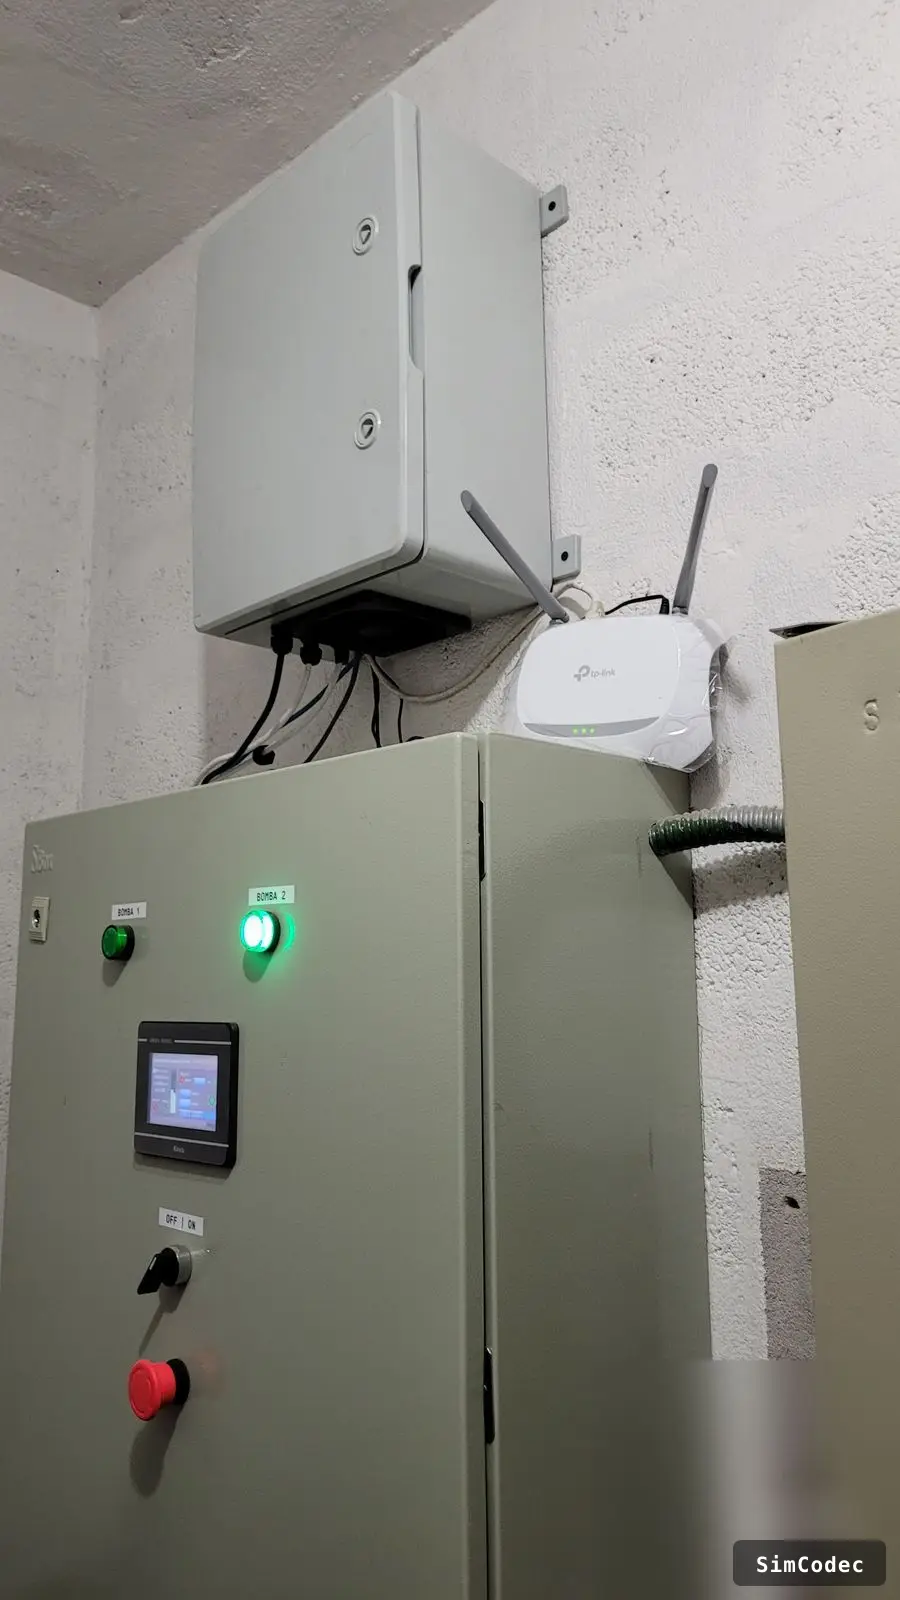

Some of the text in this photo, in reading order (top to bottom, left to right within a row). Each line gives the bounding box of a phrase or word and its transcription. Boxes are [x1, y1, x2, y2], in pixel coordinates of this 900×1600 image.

[590, 667, 616, 679] tp-link
[256, 890, 286, 902] BOMBA 2
[118, 908, 134, 916] BOMBA
[166, 1214, 178, 1224] OFF
[188, 1220, 196, 1230] ON
